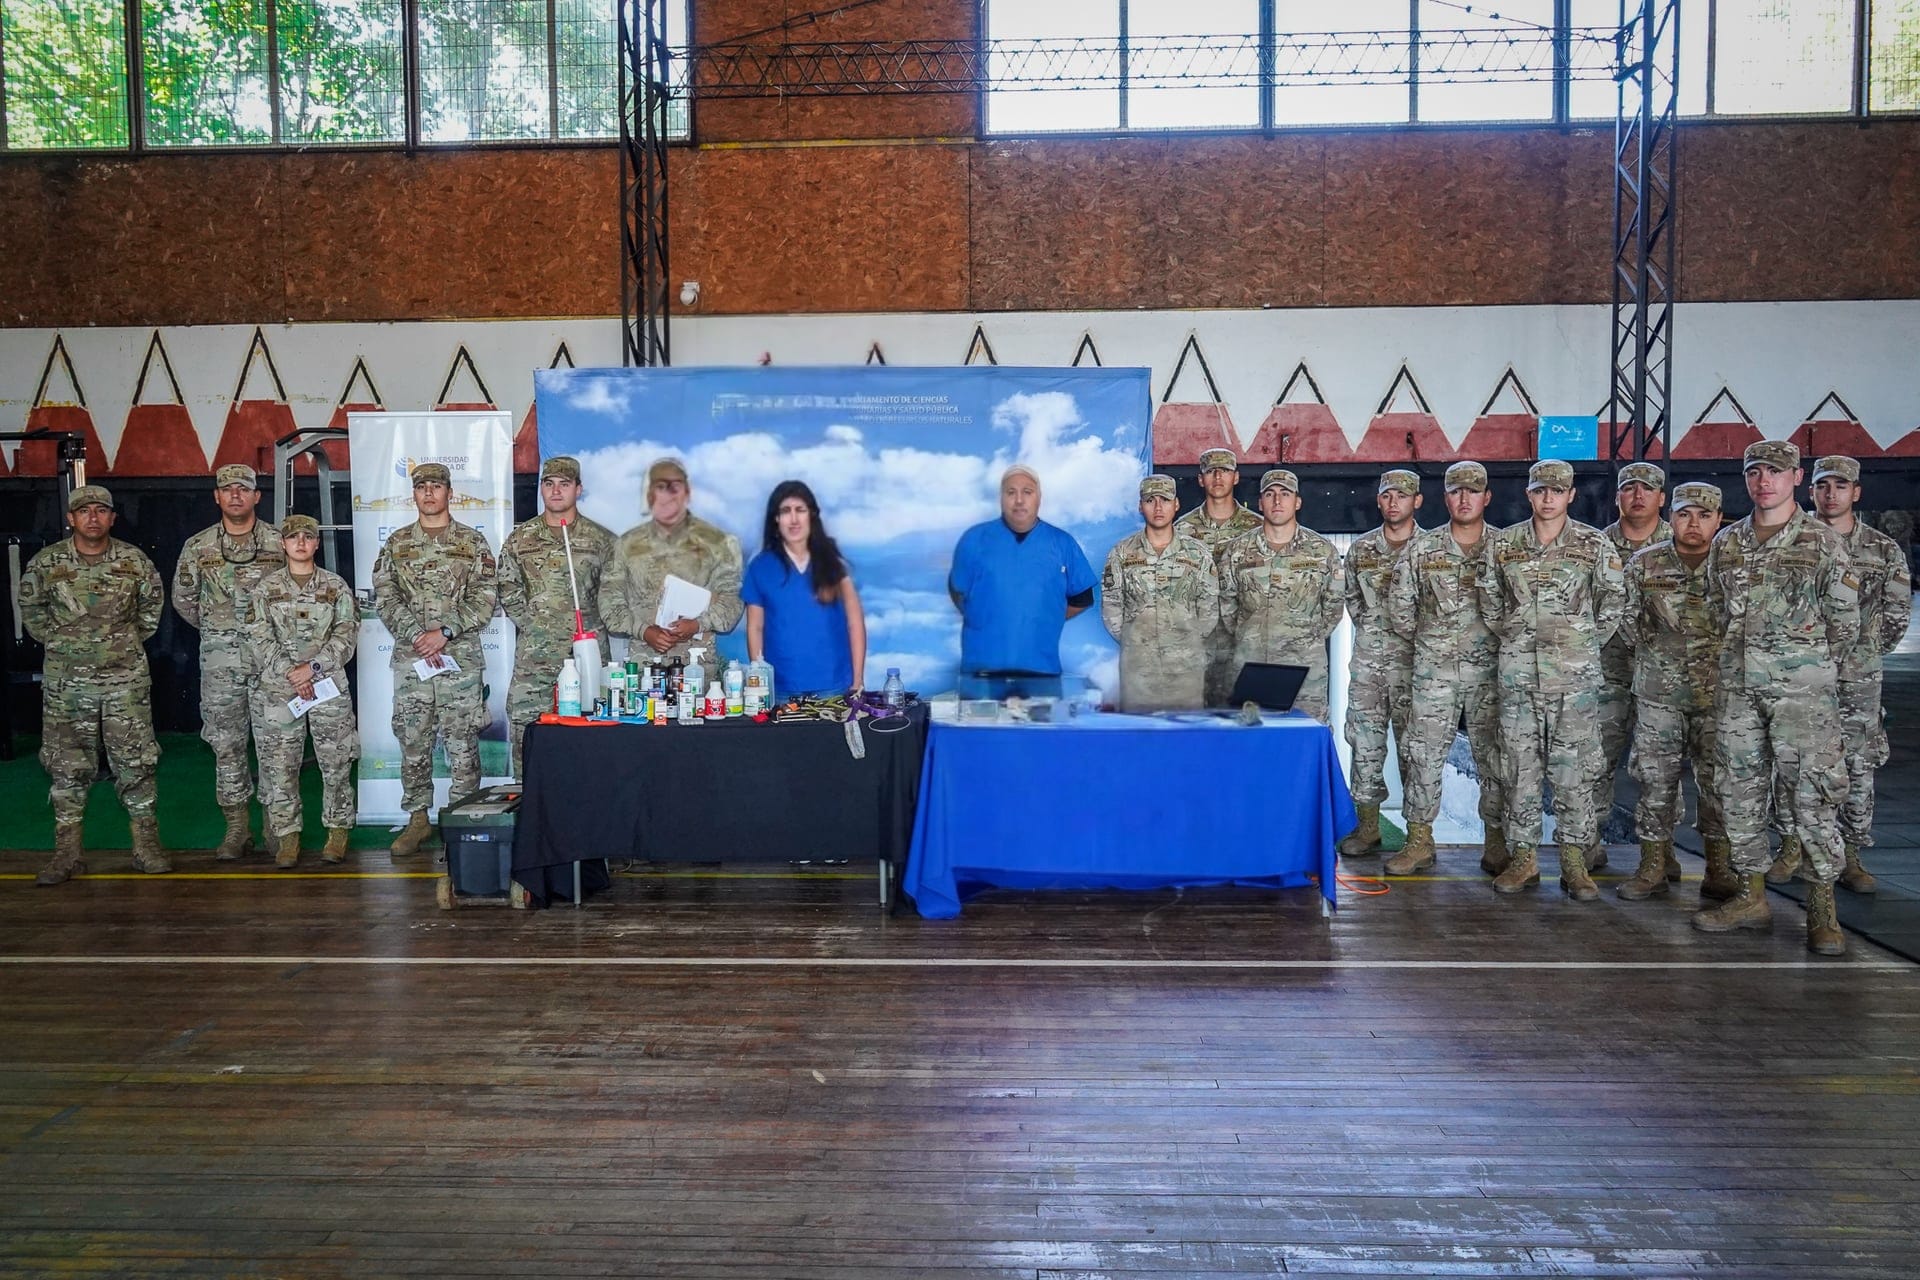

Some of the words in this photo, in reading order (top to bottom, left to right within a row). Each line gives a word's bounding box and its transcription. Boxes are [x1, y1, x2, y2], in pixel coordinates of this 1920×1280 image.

[900, 396, 911, 404] DE
[912, 396, 949, 404] CIENCIAS
[899, 406, 925, 414] SALUD
[420, 456, 470, 464] UNIVERSIDAD
